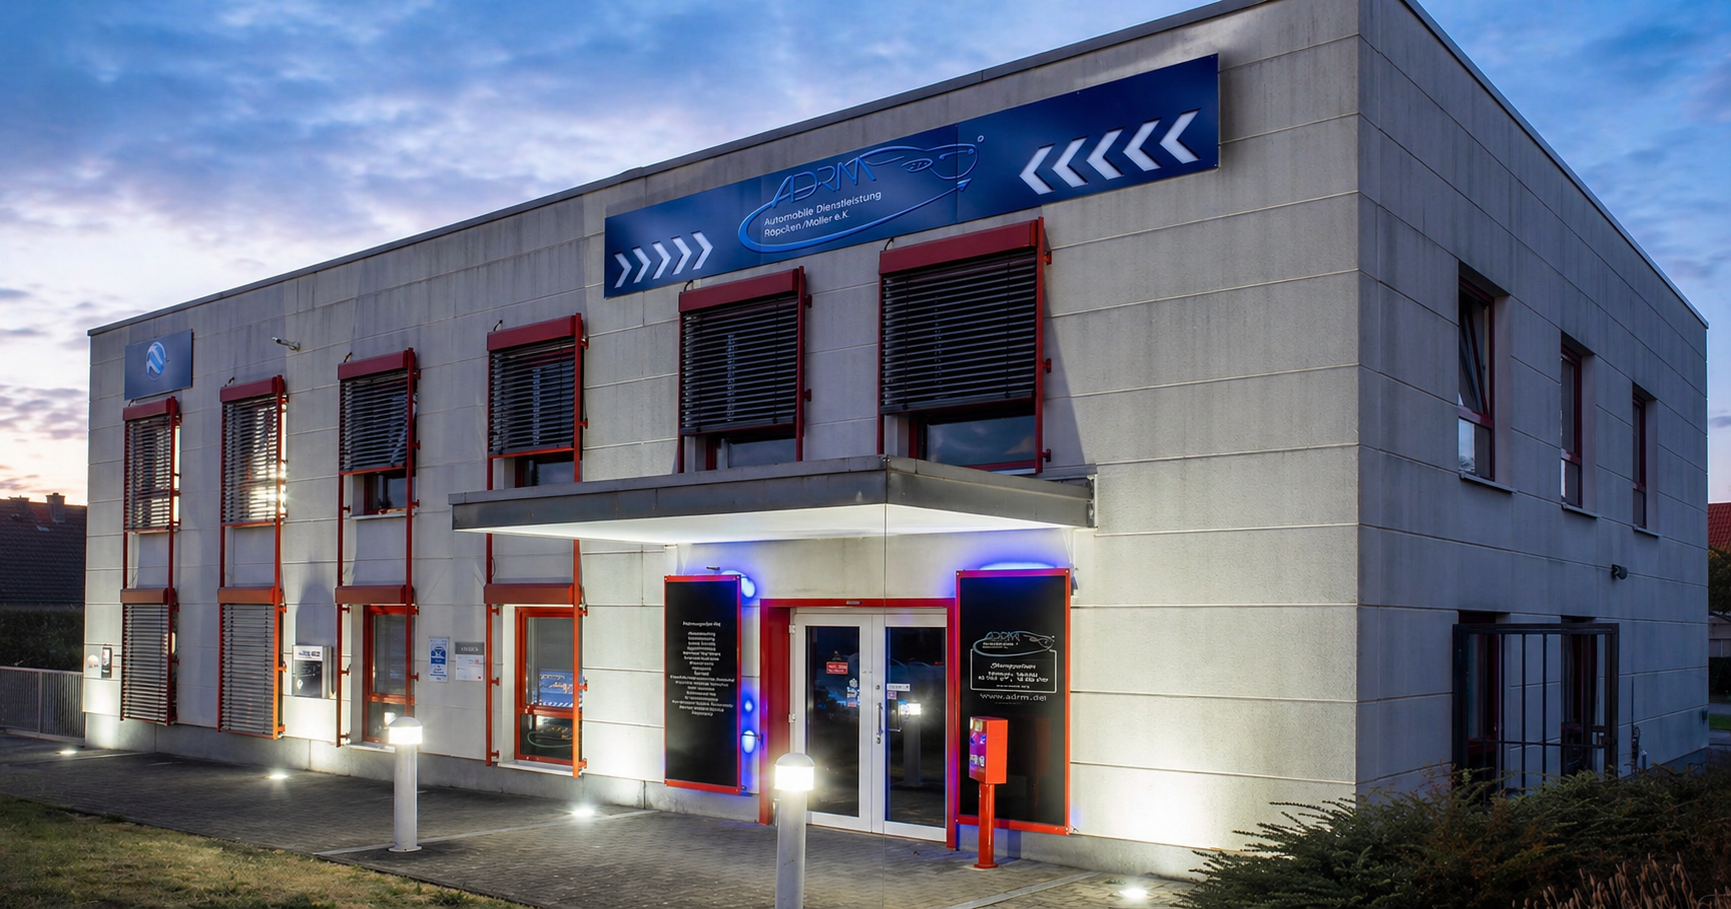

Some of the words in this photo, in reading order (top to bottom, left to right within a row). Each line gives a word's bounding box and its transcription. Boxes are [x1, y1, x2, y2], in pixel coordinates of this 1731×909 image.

[771, 156, 876, 207] ADRM
[764, 208, 813, 226] Automobile
[816, 192, 882, 213] Dienstleistung
